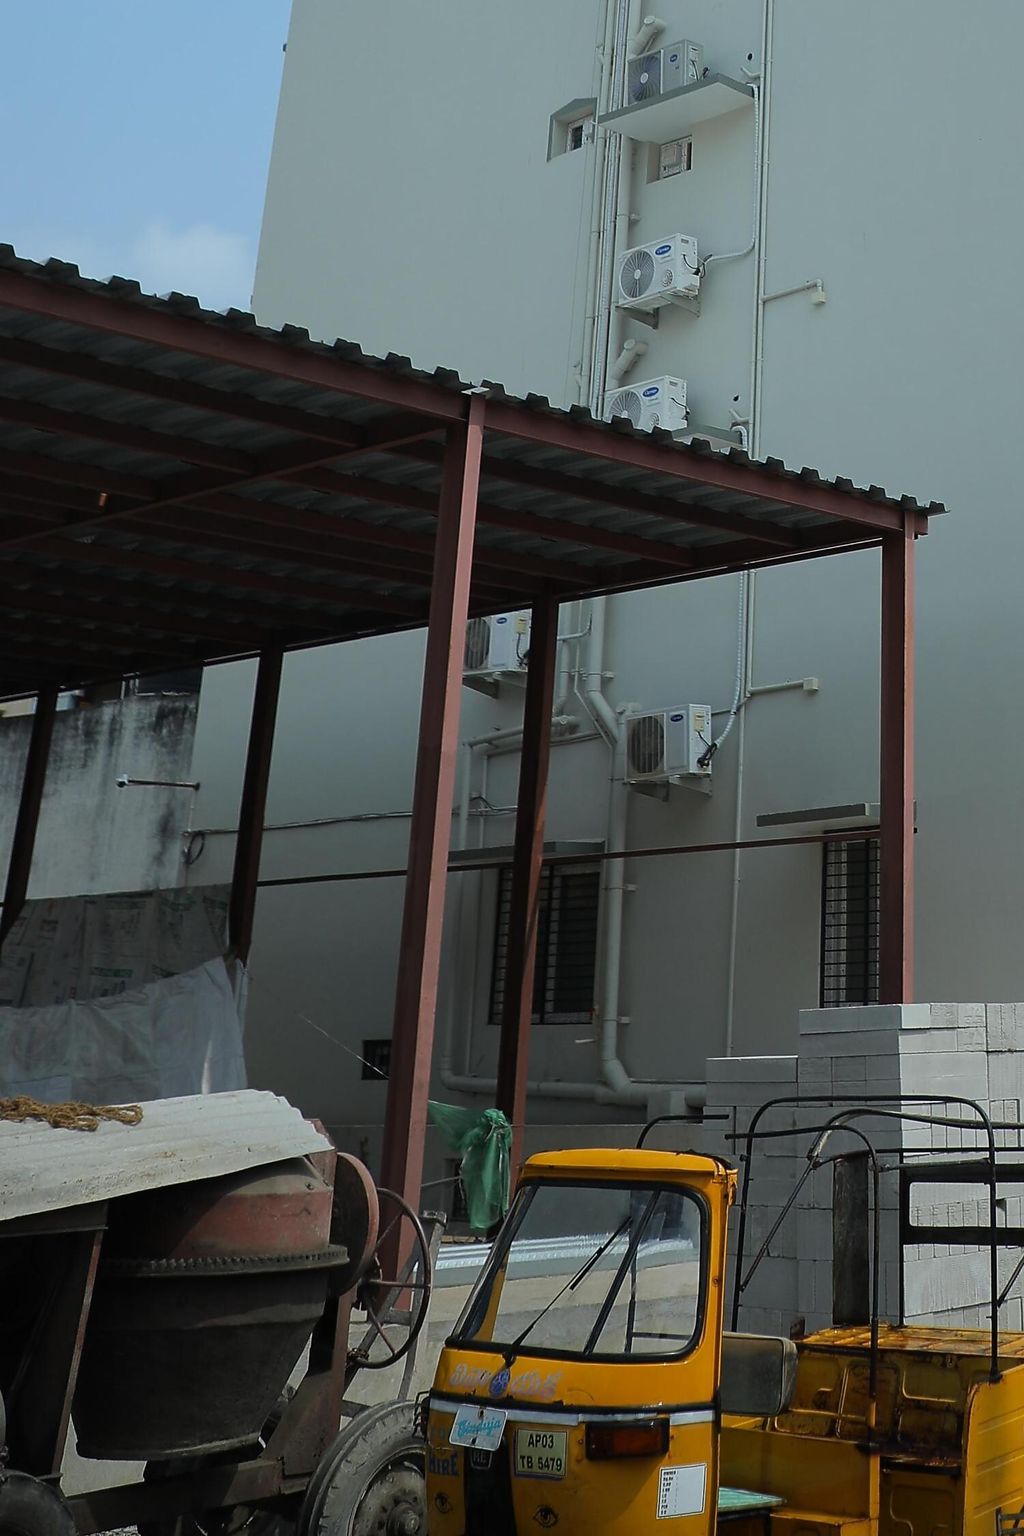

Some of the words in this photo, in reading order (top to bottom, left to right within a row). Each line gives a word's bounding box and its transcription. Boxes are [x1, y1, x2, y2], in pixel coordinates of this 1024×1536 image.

[528, 1433, 554, 1449] AP03
[520, 1455, 533, 1469] TB
[537, 1456, 562, 1472] 5479
